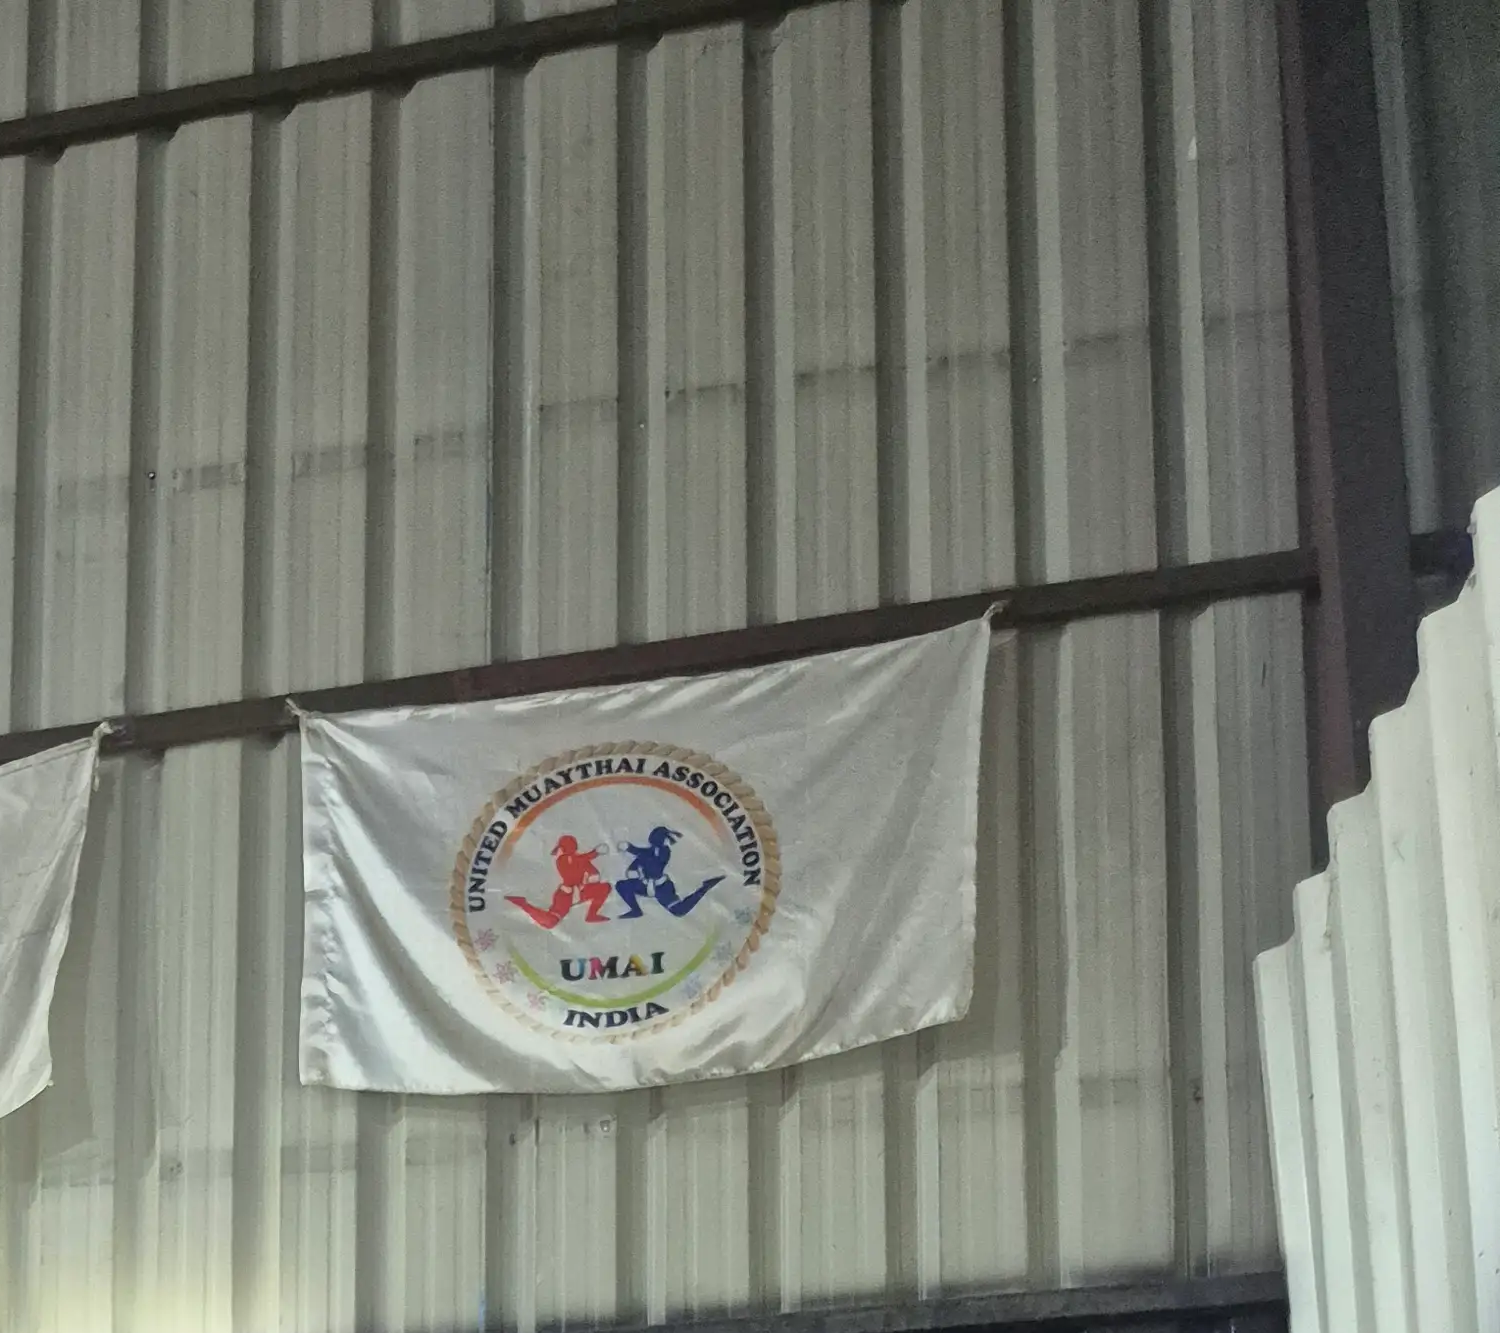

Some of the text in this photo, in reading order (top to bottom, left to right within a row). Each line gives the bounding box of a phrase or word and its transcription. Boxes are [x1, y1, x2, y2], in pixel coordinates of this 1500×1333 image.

[468, 757, 762, 913] UNITED MUAYTHAI ASSOCIATION
[559, 951, 666, 982] UMAI
[562, 1001, 670, 1029] INDIA
